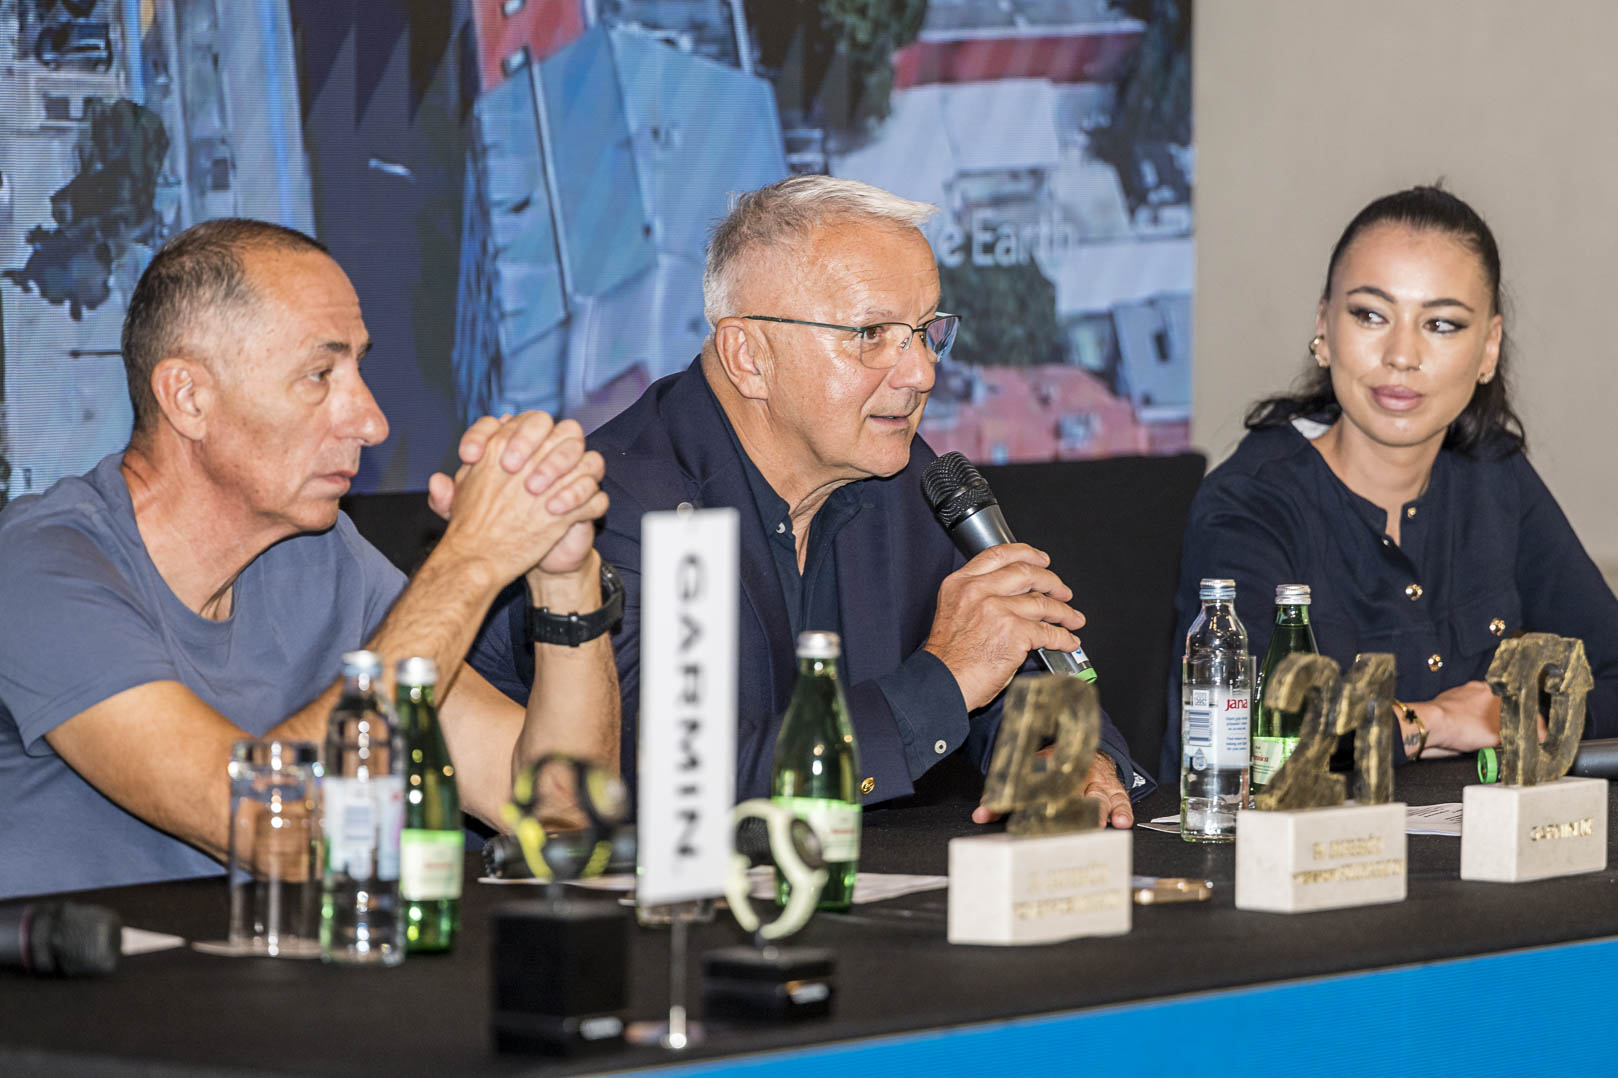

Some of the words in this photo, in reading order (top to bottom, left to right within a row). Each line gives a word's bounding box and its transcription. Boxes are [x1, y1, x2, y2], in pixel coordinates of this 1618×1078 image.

[971, 207, 1079, 267] Earth
[675, 552, 708, 859] GARMIN
[1225, 698, 1248, 711] Jana
